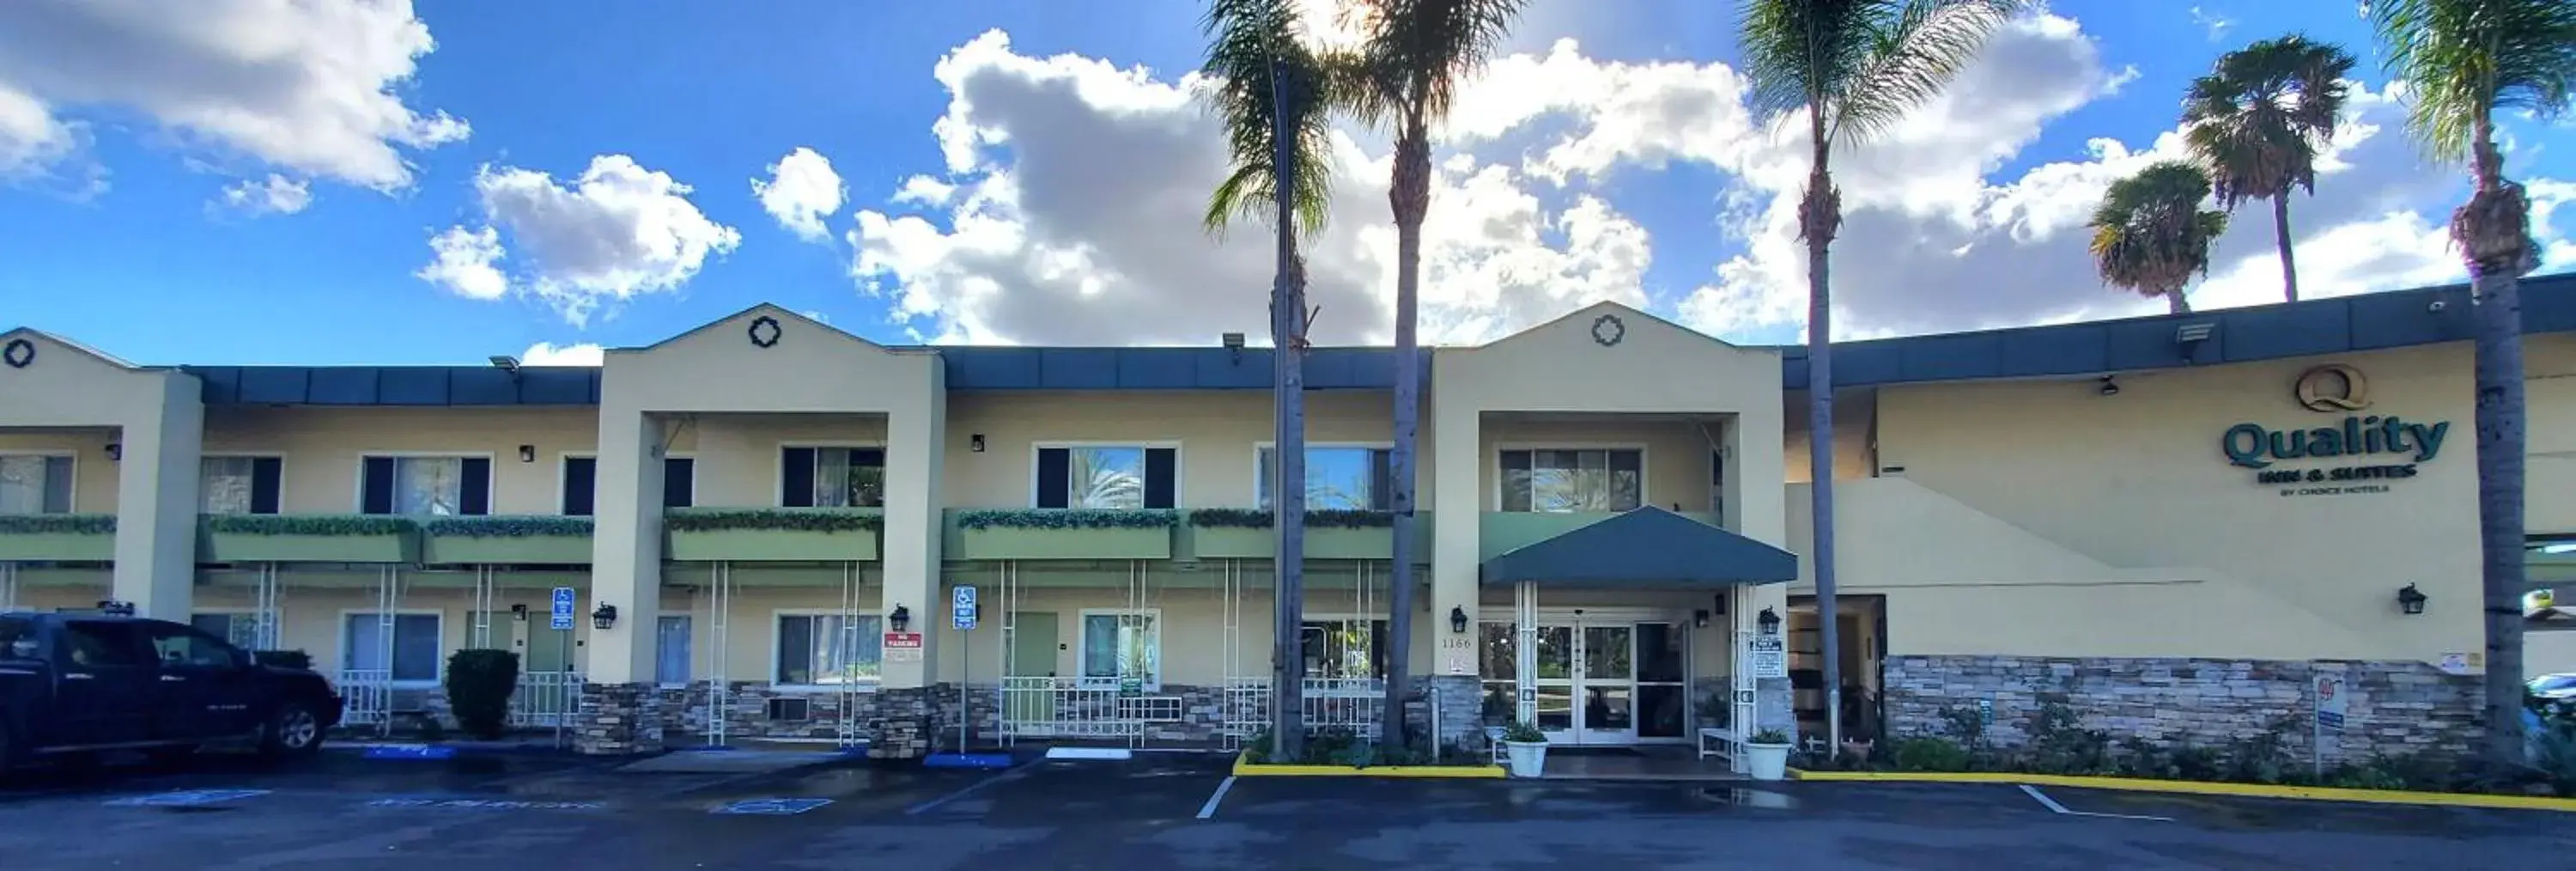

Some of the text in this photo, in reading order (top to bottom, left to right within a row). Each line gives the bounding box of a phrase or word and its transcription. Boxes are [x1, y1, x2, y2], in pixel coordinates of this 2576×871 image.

[2222, 415, 2450, 469] Quality
[2258, 464, 2418, 484] INN & SUITES
[2298, 487, 2341, 496] CHOICE
[2343, 485, 2390, 494] HOTELS
